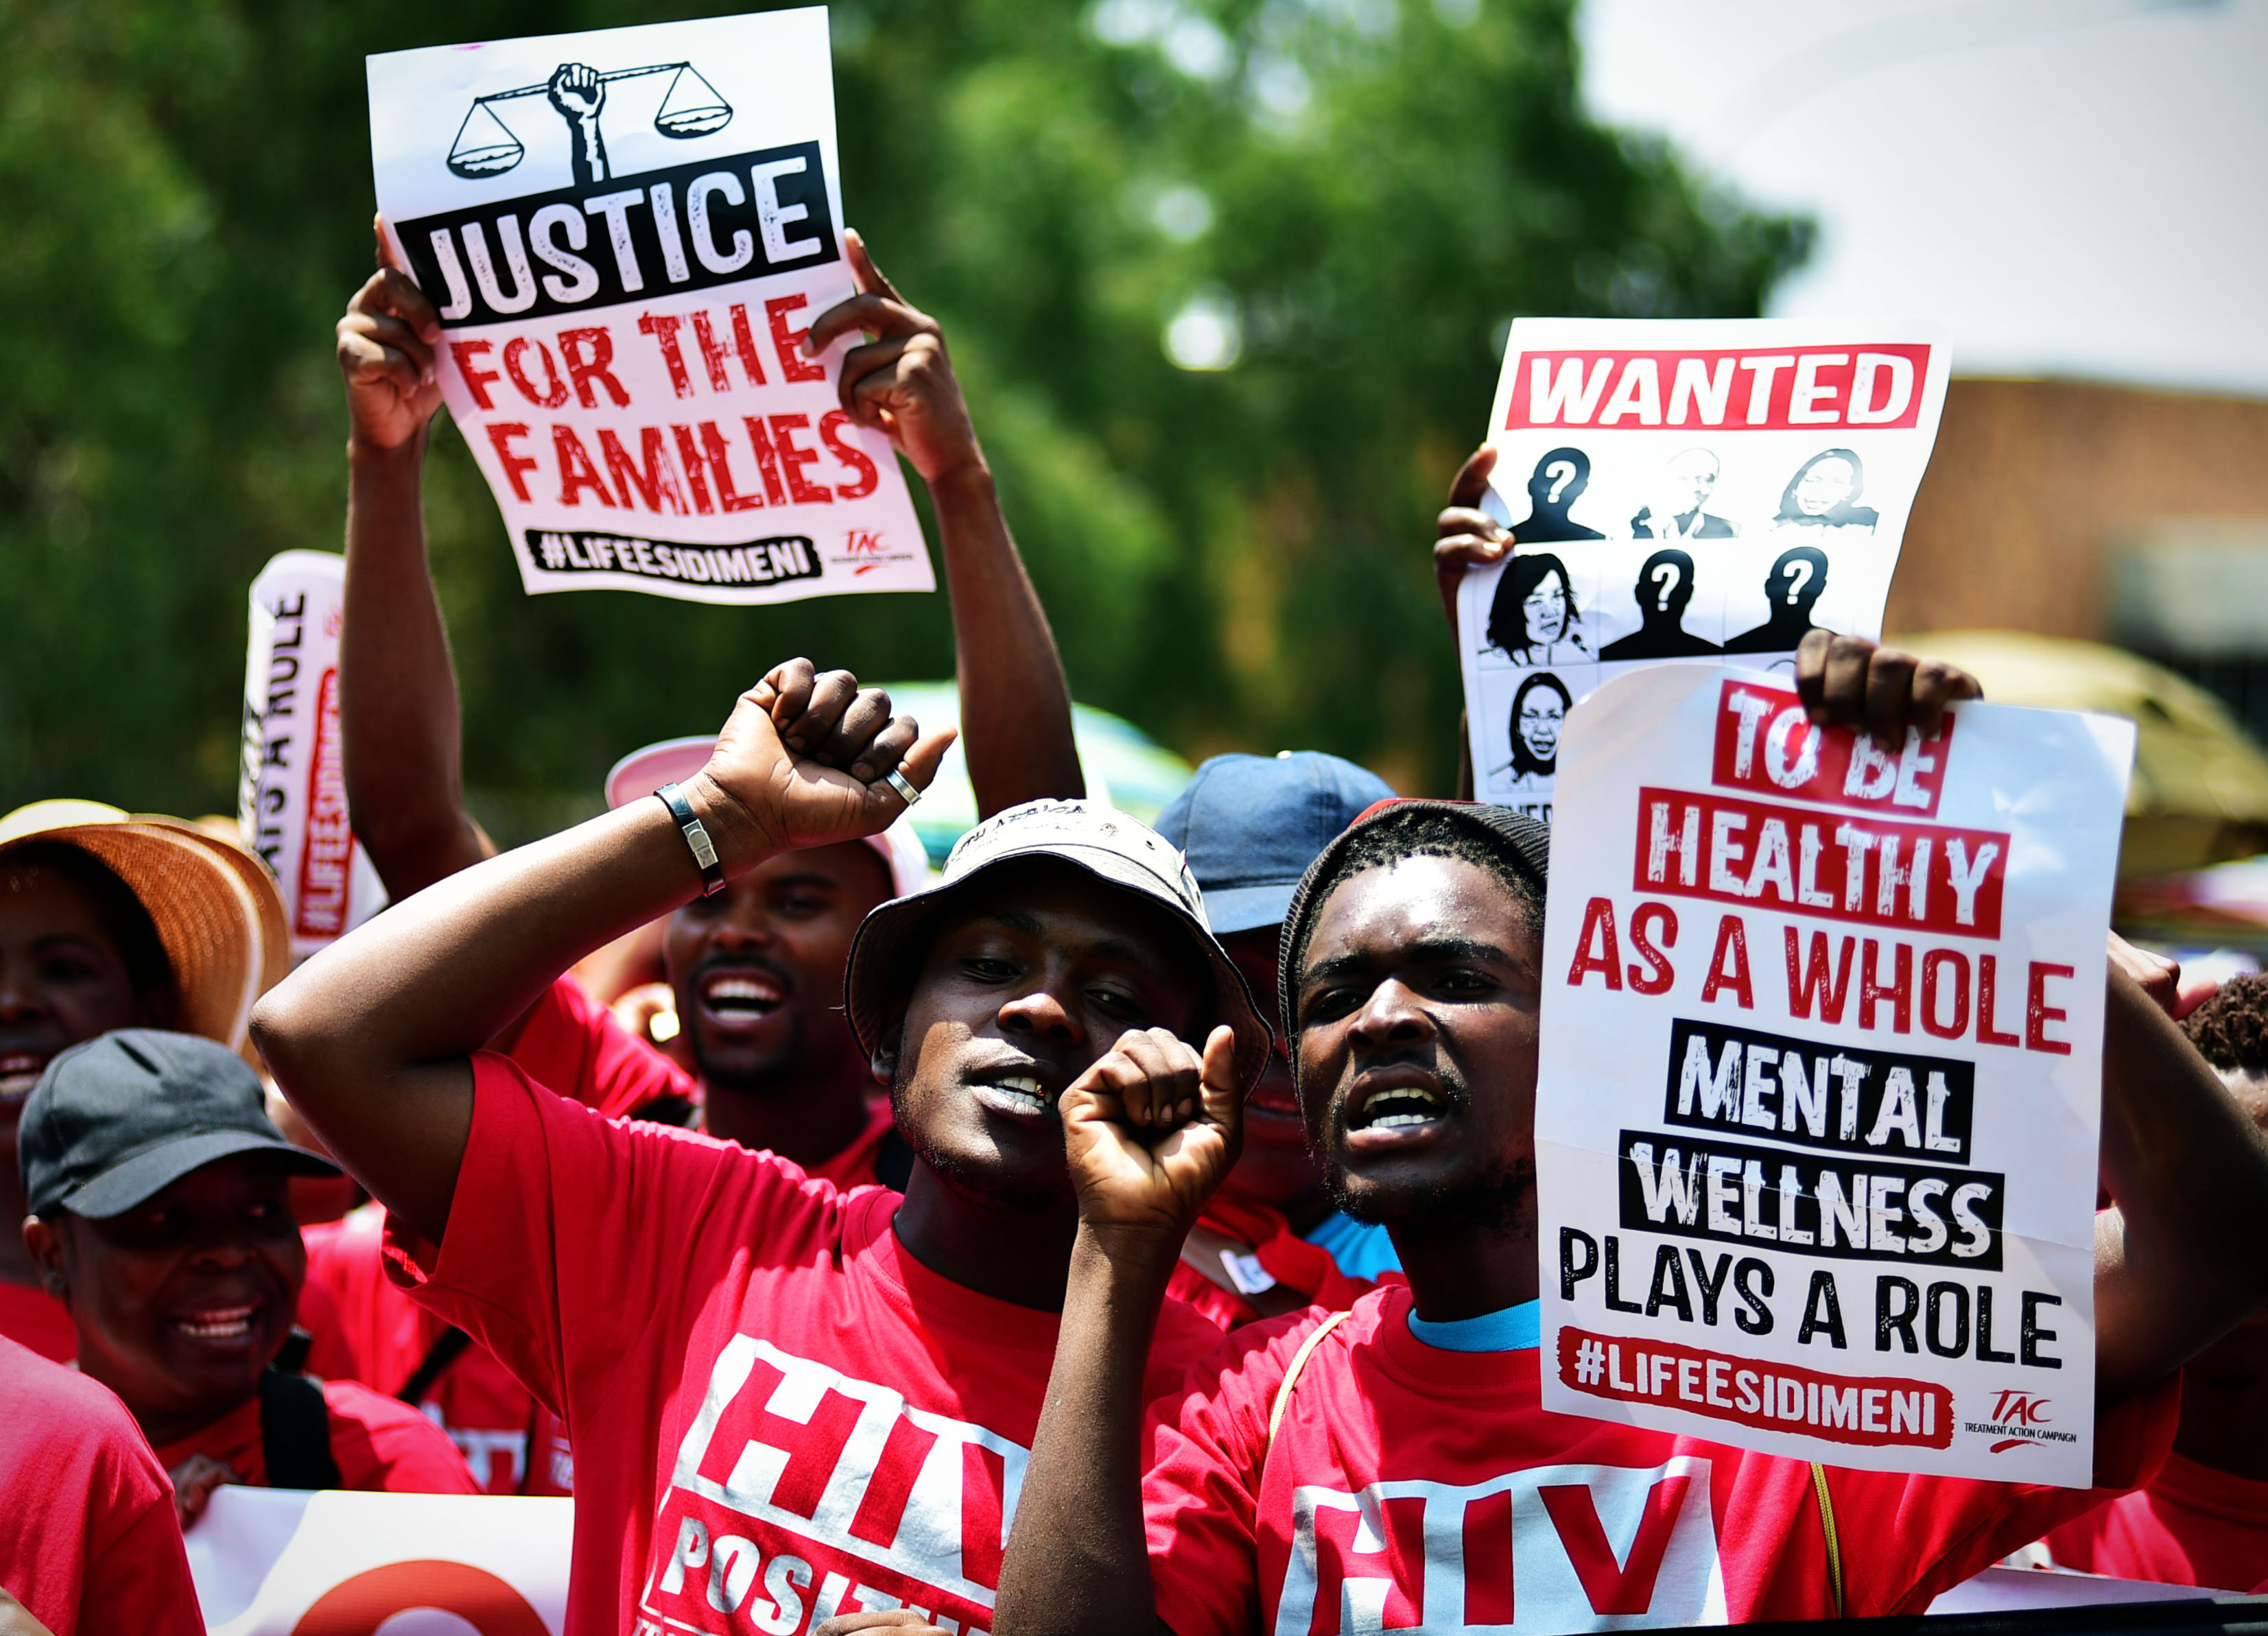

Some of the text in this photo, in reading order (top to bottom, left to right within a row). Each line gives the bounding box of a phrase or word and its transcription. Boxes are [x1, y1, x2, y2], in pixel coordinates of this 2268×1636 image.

[430, 156, 823, 320] JUSTICE
[450, 293, 826, 410] FOR THE
[1528, 353, 1915, 425] WANTED
[485, 410, 879, 517] FAMILIES
[541, 534, 811, 583] #LIFEESIDIMENI
[841, 528, 890, 554] TAC
[1729, 689, 1941, 809] TO BE
[1648, 801, 1998, 926] HEALTHY
[1567, 897, 2075, 1056] AS A WHOLE
[1676, 1035, 1962, 1152] MENTAL
[1629, 1142, 1994, 1259] WELLNESS
[1559, 1226, 2063, 1370] PLAYS A ROLE
[1575, 1338, 1935, 1436] #LIFEESIDIMENI
[1964, 1422, 2077, 1443] TREATMENT ACTION CAMPAIGN
[1989, 1389, 2053, 1426] TAC
[1308, 1476, 1692, 1636] HIV
